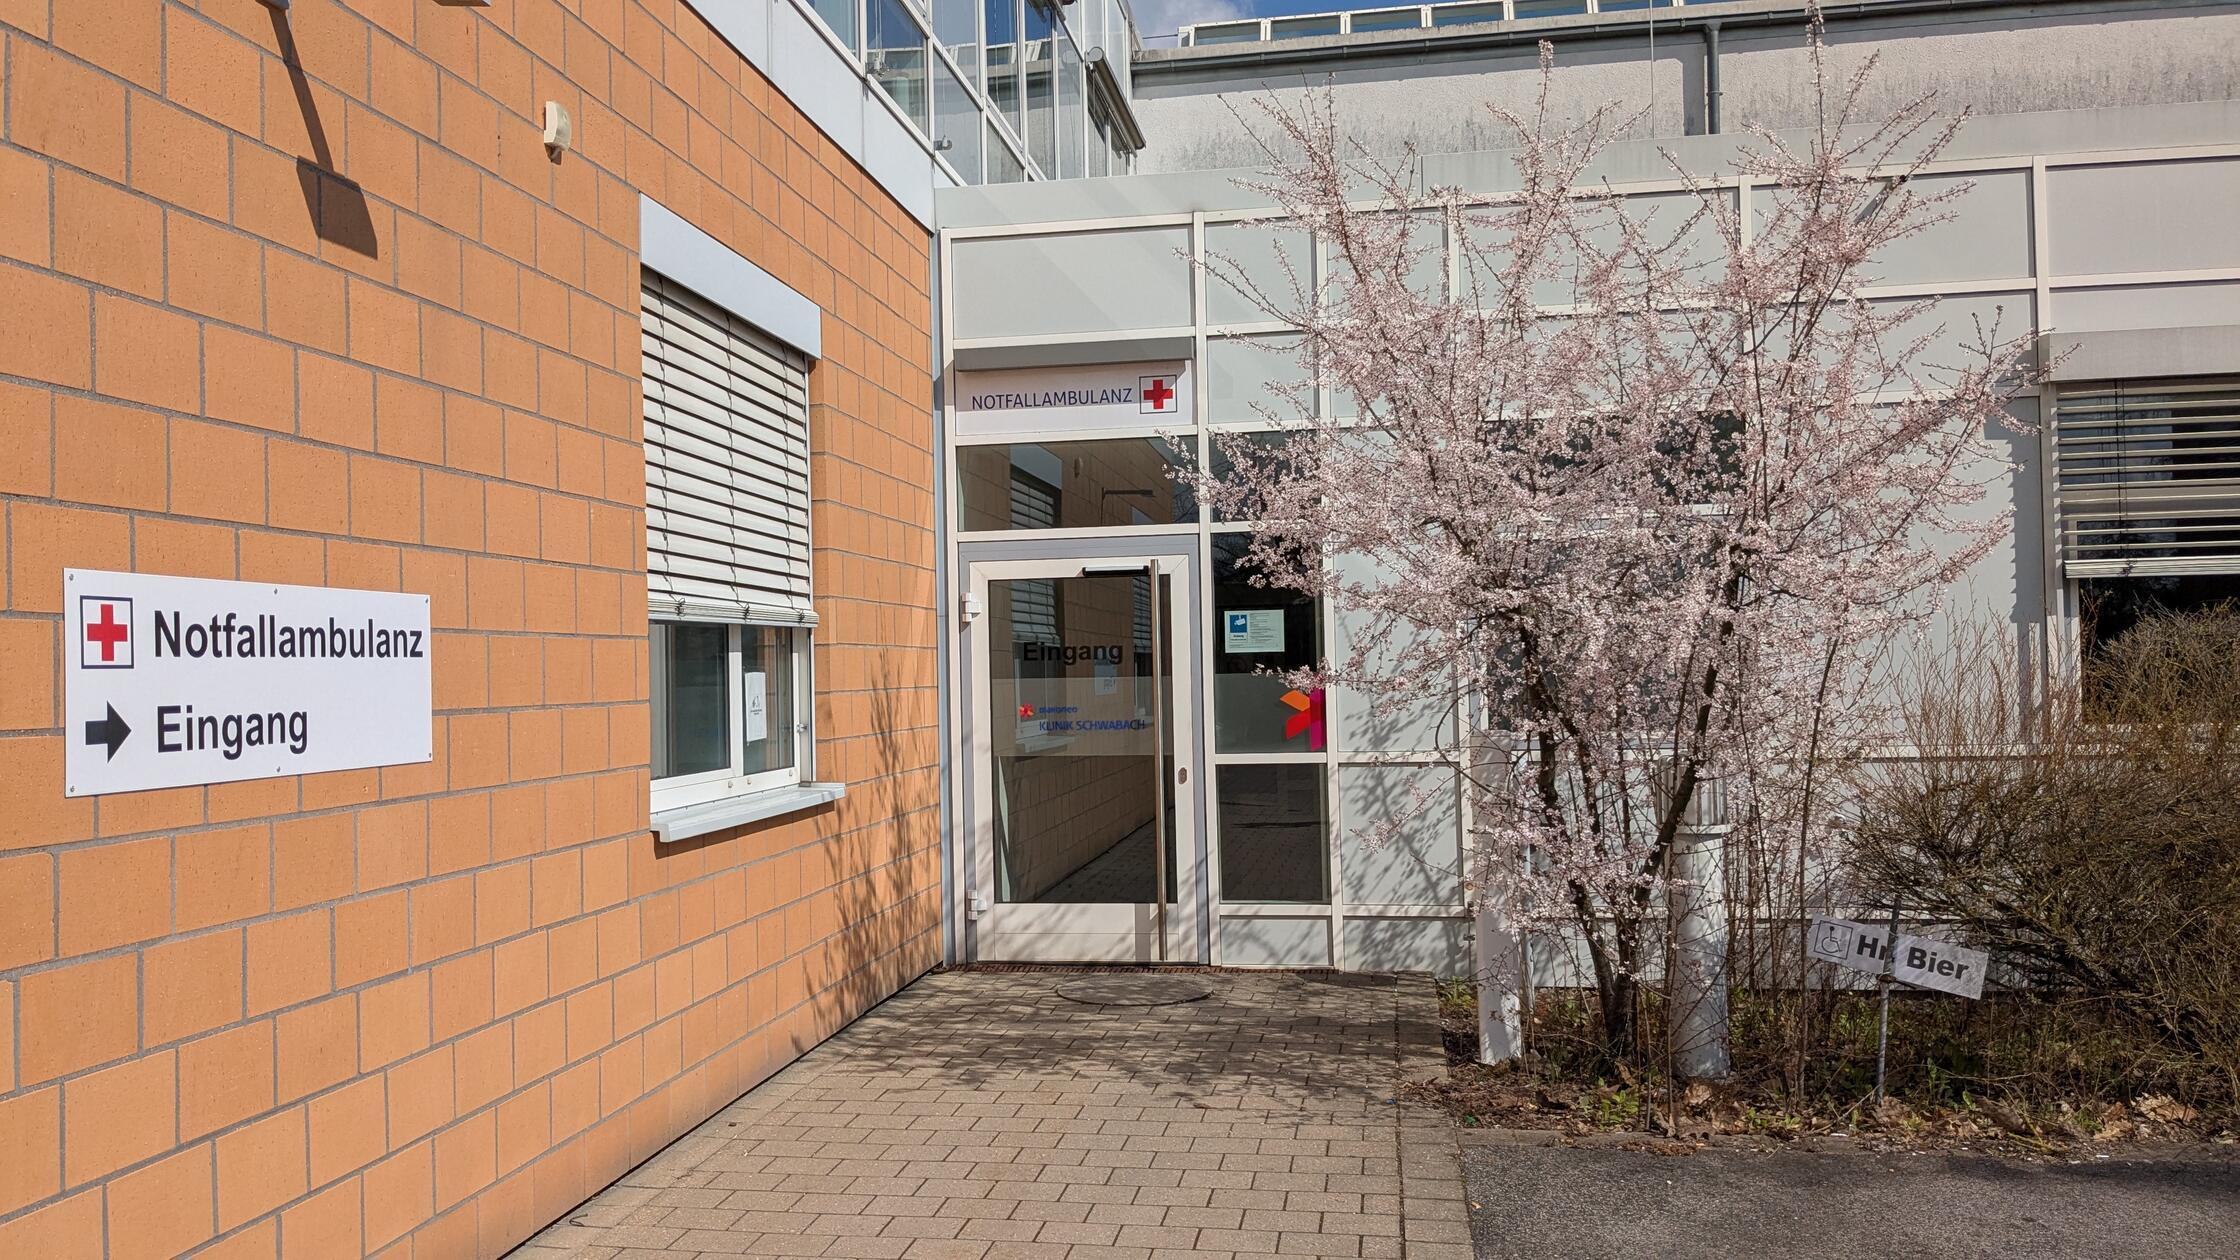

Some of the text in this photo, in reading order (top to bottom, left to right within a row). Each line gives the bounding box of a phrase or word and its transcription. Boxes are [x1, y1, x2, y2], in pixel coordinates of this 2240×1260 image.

[972, 388, 1133, 410] NOTFALLAMBULANZ
[153, 610, 424, 658] Notfallambulanz
[1023, 641, 1123, 665] Eingang
[156, 704, 308, 760] Eingang
[1039, 719, 1146, 732] KLINIK SCHWABACH
[1906, 946, 1970, 980] Bier
